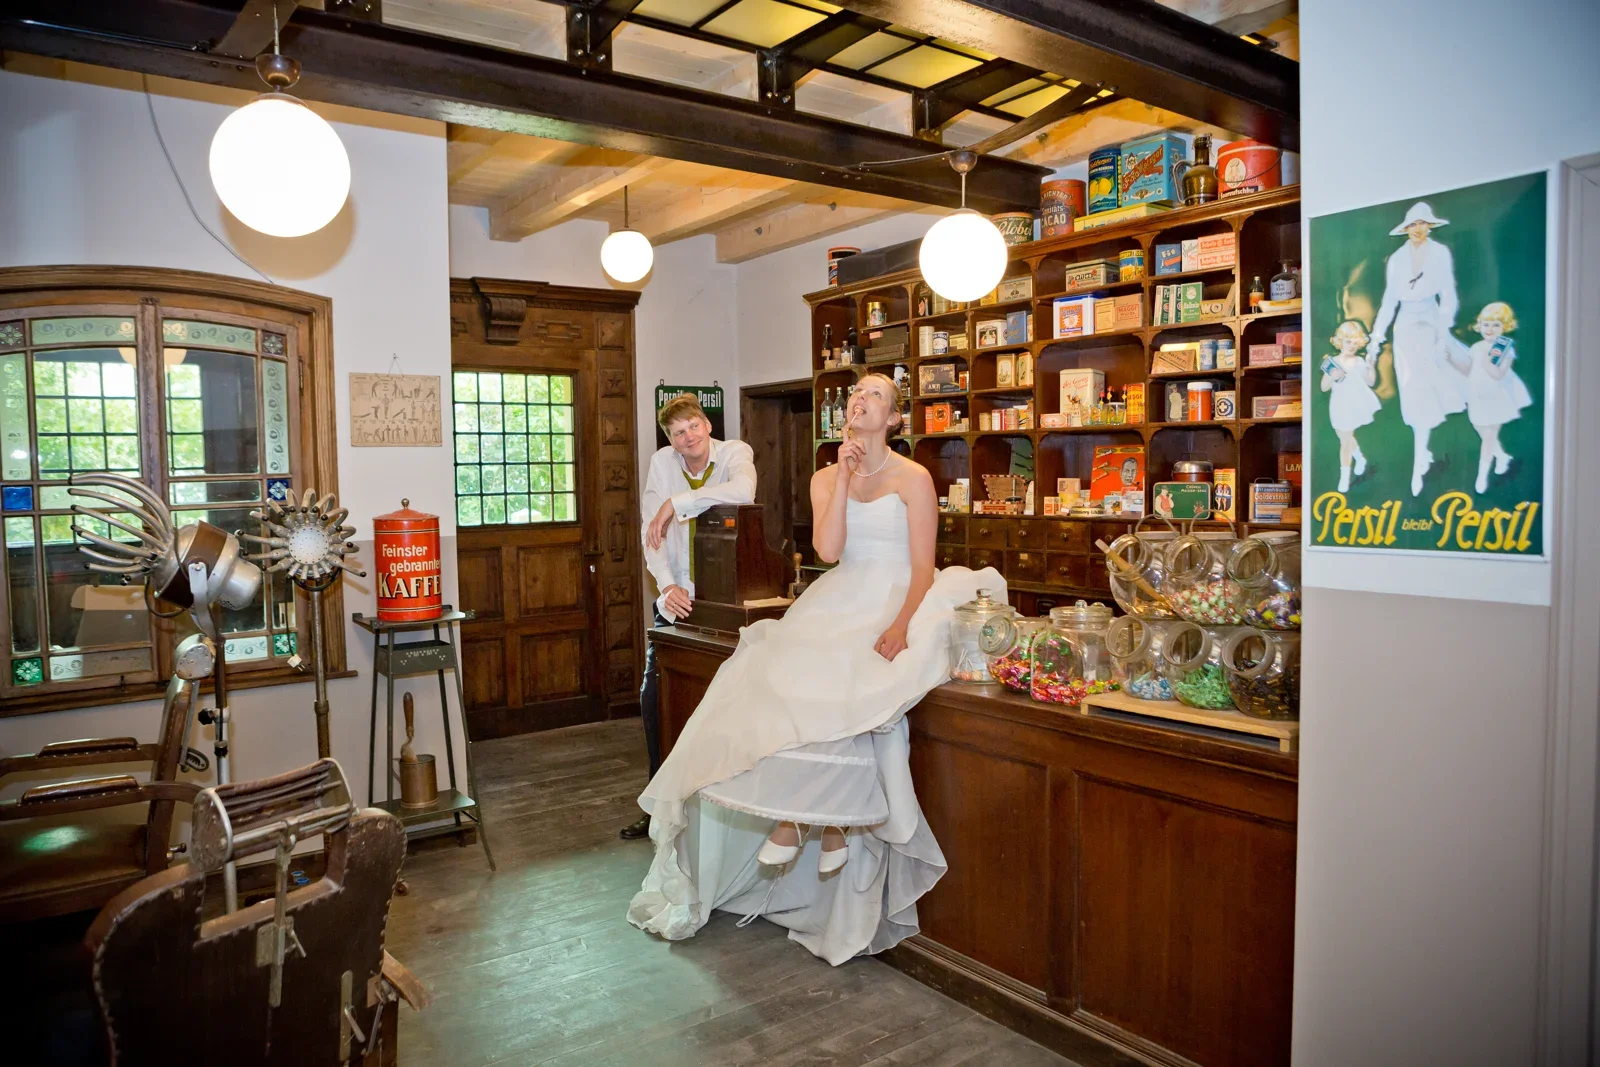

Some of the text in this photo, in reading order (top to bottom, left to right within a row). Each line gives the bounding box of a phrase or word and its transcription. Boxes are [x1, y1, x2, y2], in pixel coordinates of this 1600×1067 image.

[697, 390, 721, 408] Persil
[1313, 491, 1540, 552] Persil bleibt Persil
[382, 544, 428, 557] Feinster
